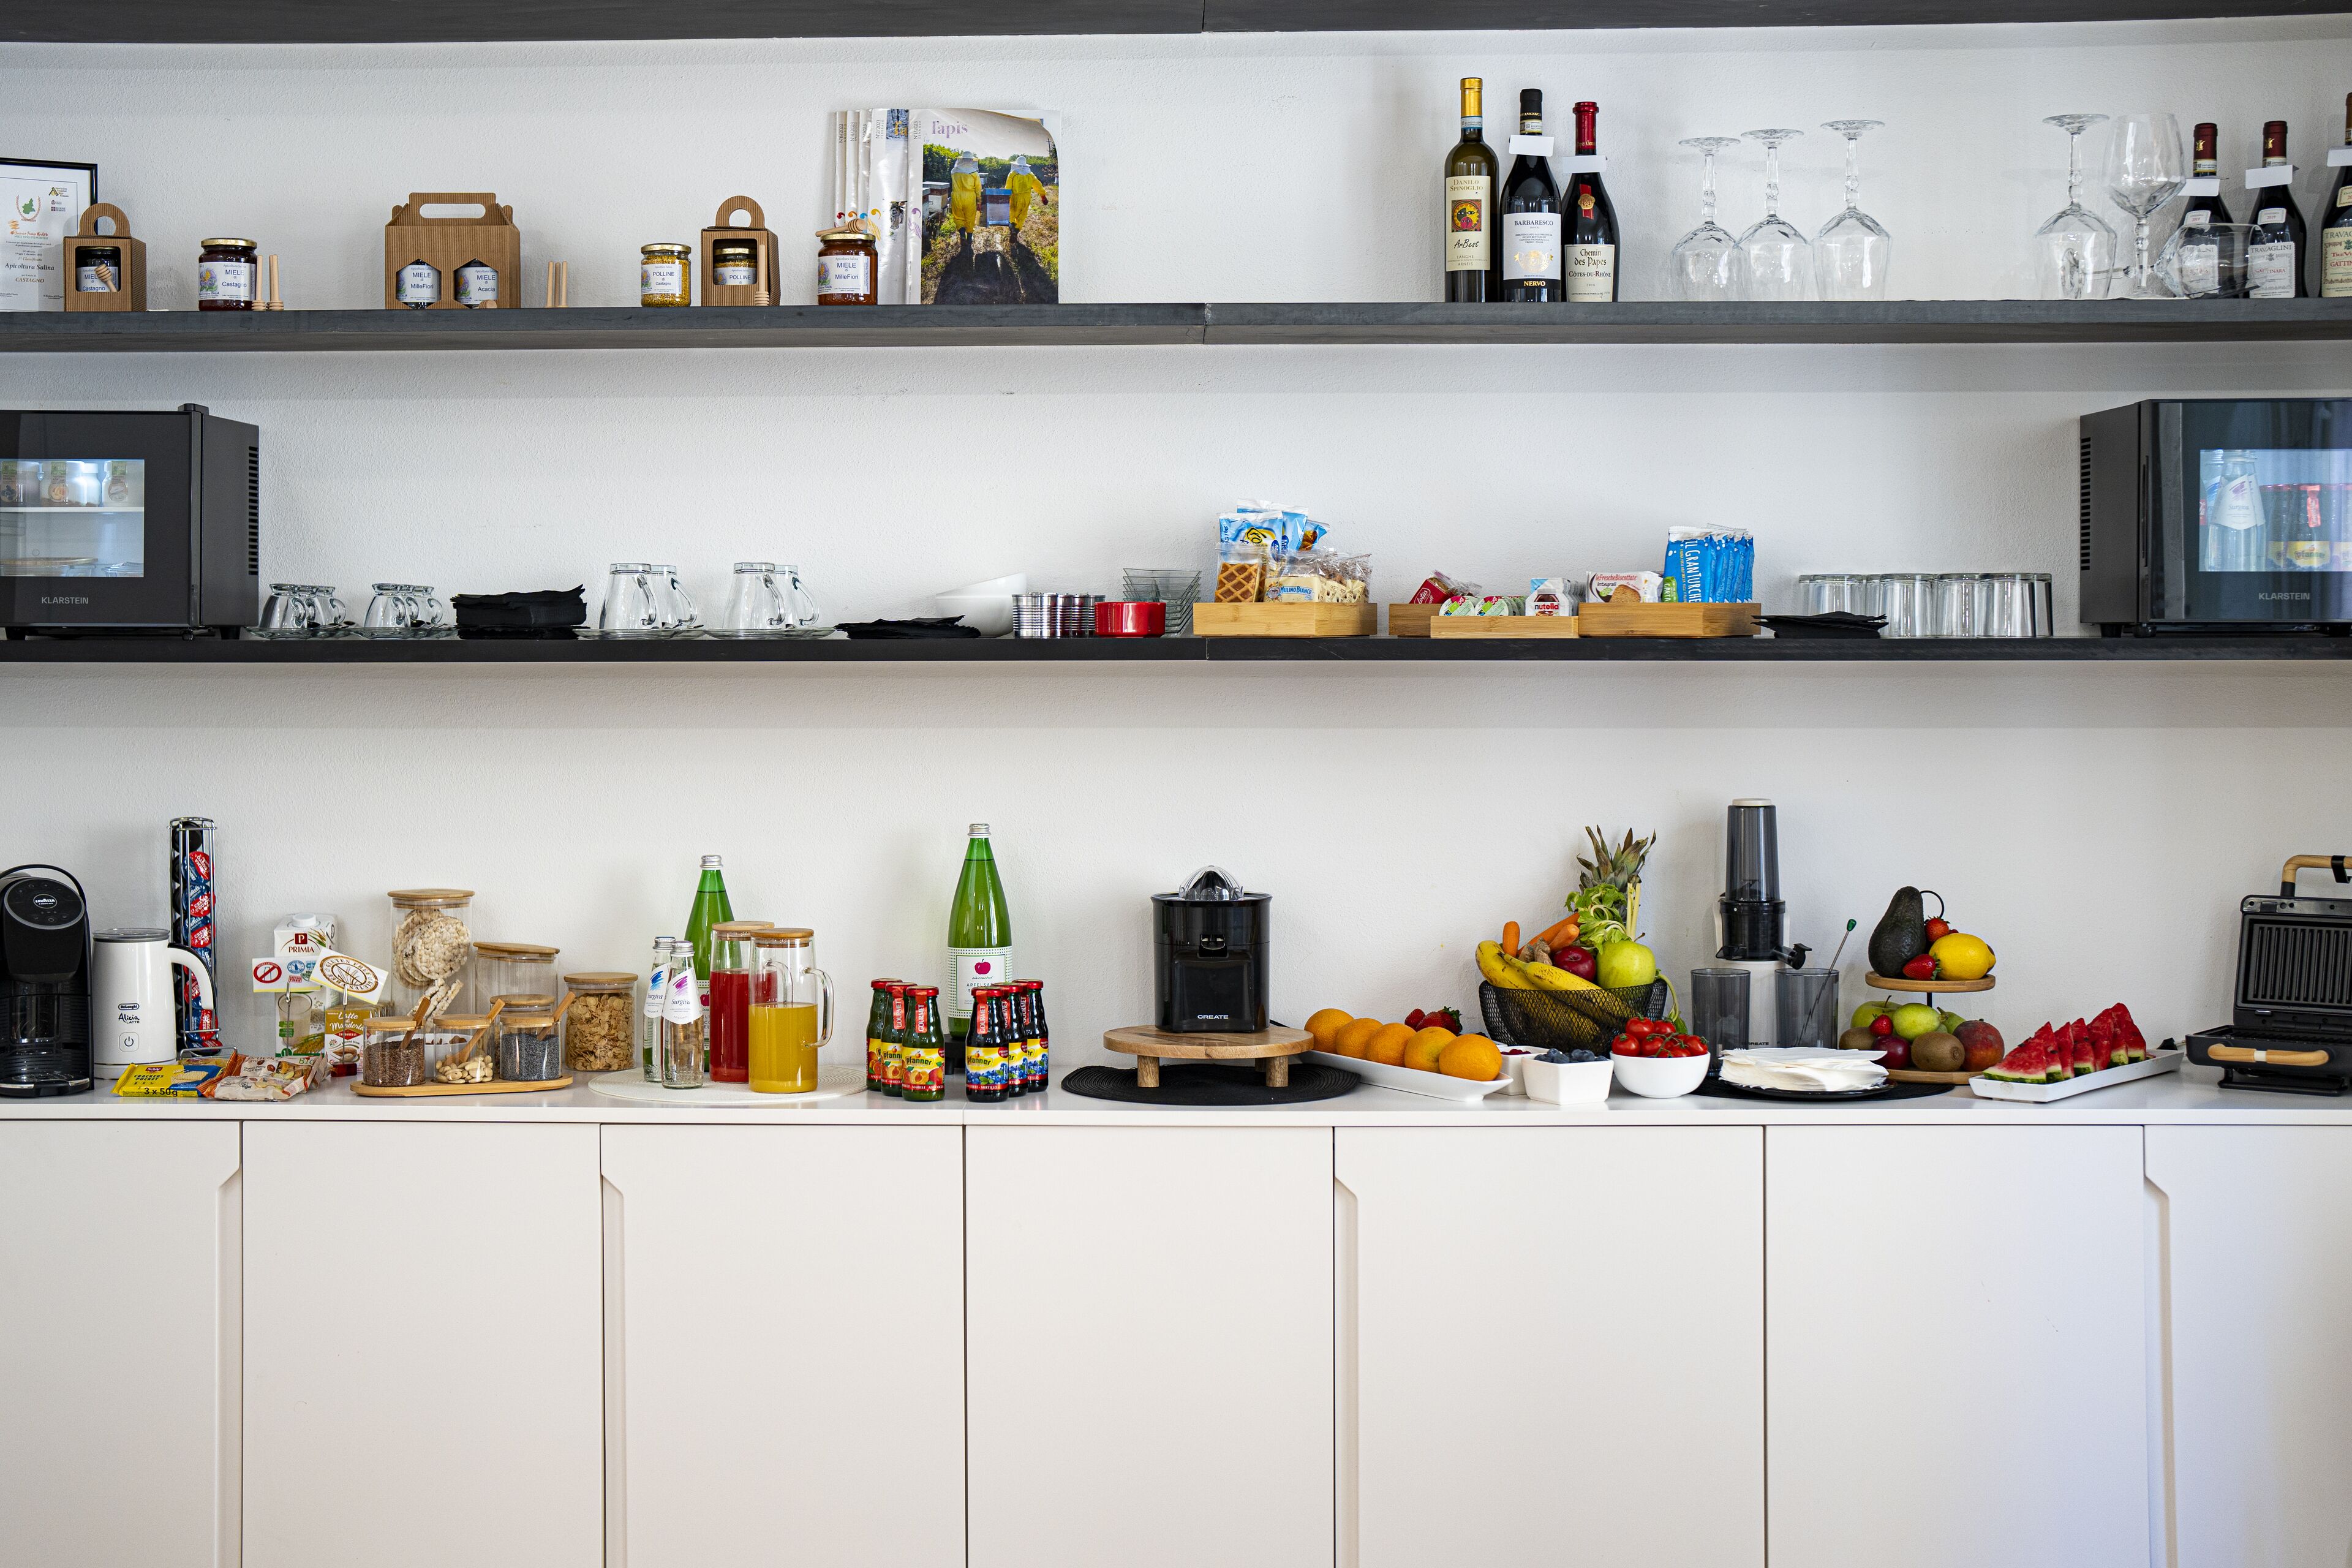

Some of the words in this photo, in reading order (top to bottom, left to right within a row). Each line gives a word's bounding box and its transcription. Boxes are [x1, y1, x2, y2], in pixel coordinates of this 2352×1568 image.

[1454, 239, 1479, 249] ArBest
[1580, 249, 1601, 257] Chemin
[1588, 258, 1606, 269] Papes
[326, 959, 350, 967] GLUTEN
[118, 1013, 140, 1023] Alicia
[330, 1022, 366, 1031] Mandorla
[907, 1057, 932, 1065] Pfanner
[160, 1088, 178, 1097] 50g
